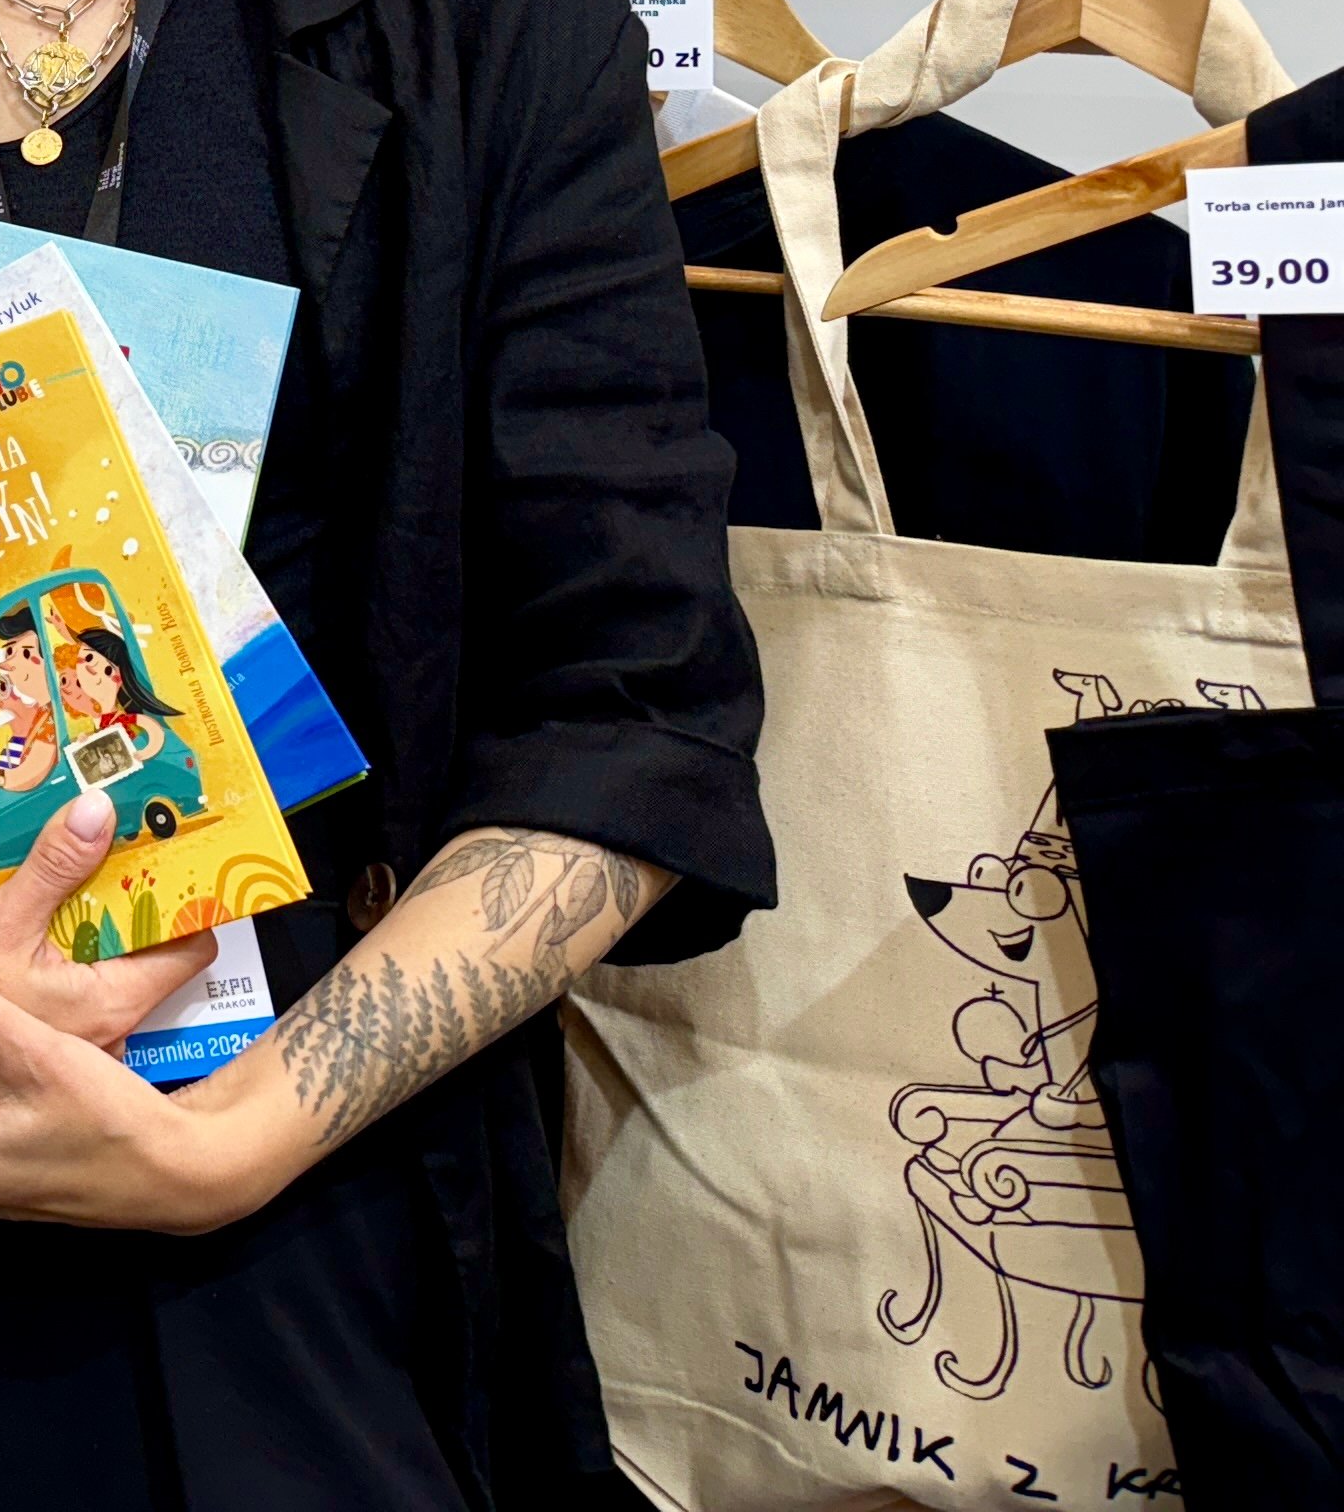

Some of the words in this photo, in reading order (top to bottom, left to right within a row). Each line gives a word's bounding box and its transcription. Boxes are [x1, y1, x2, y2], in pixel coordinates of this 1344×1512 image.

[675, 47, 702, 68] zł
[1204, 201, 1251, 212] Torba
[1256, 199, 1315, 211] ciemna
[1211, 257, 1330, 290] 39,00
[170, 634, 196, 677] JOANNA
[205, 976, 254, 999] EXPO
[123, 1039, 205, 1069] dziernika
[734, 1339, 957, 1482] JAMNIK
